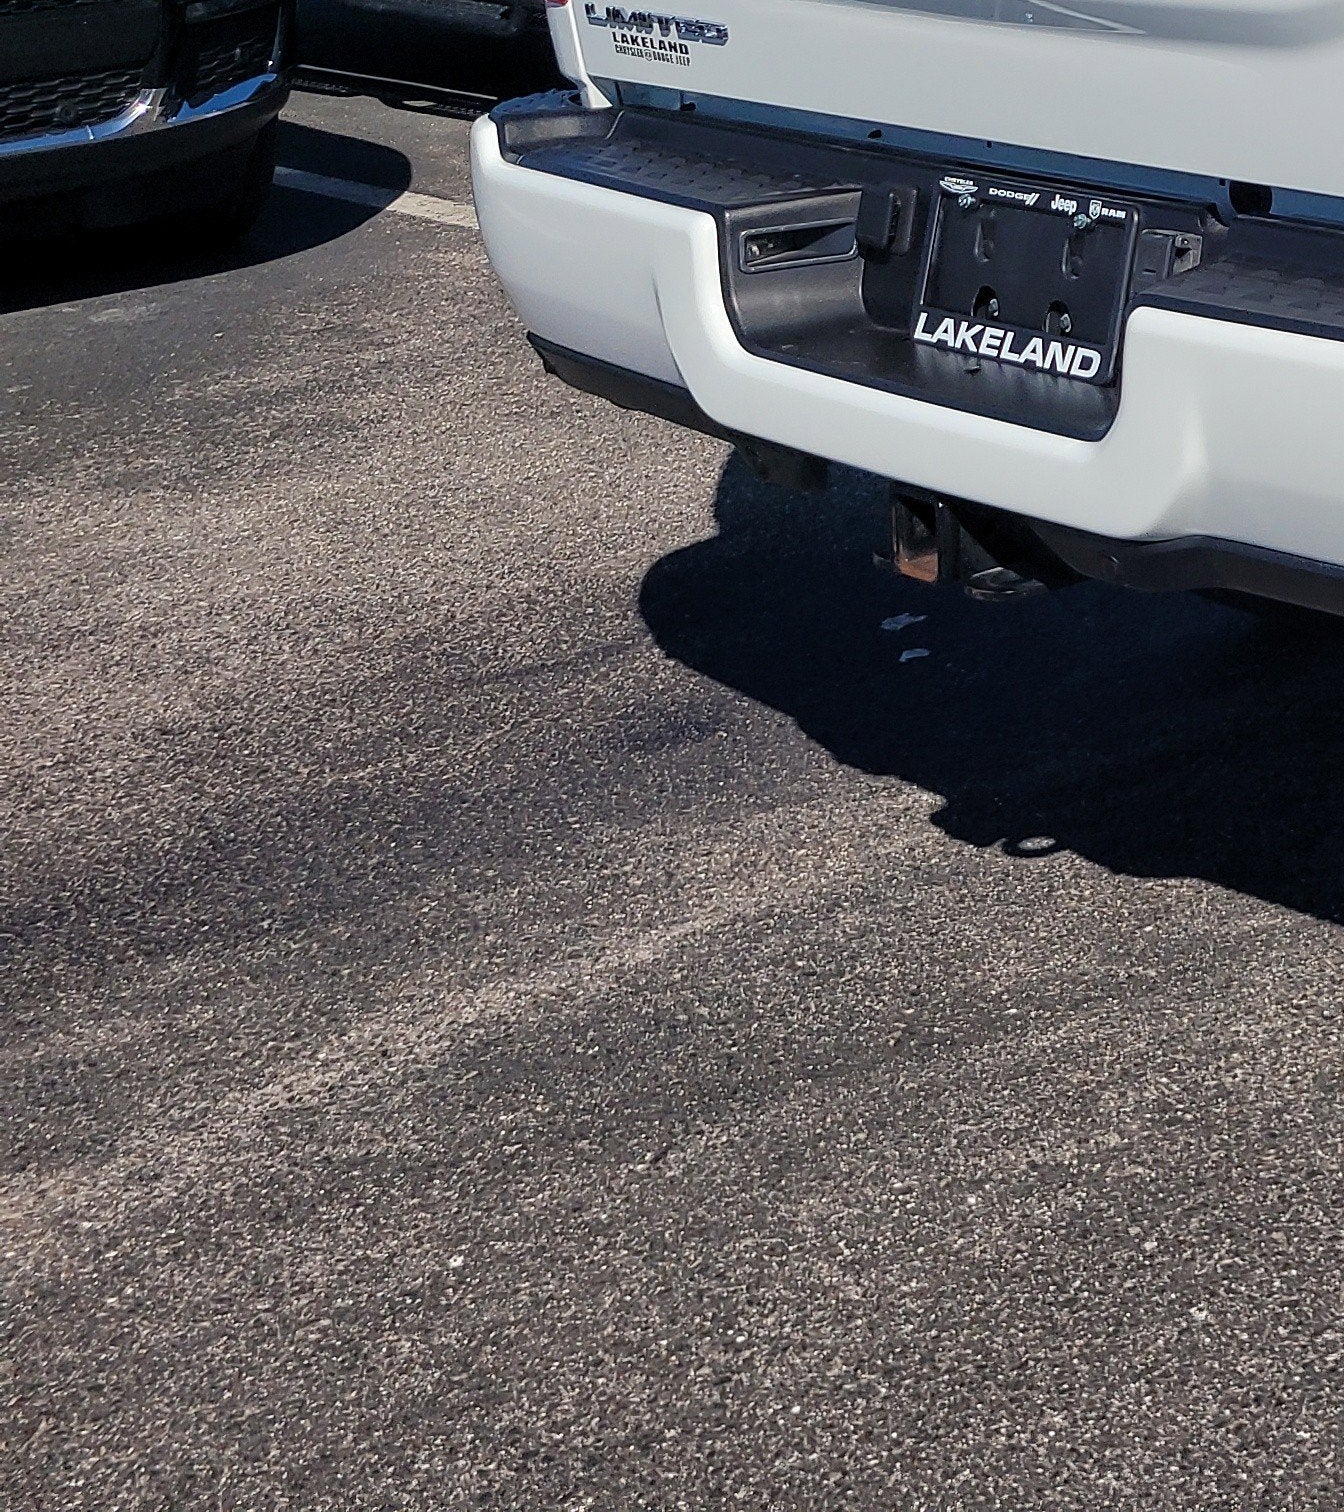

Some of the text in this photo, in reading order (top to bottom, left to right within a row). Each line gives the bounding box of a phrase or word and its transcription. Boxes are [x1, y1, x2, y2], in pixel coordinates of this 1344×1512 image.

[584, 1, 729, 46] LIMITED
[612, 31, 690, 55] LAKELAND
[988, 187, 1032, 202] DODGE
[1050, 194, 1078, 216] Jeep
[1101, 207, 1127, 219] RAM
[913, 311, 1101, 379] LAKELAND
